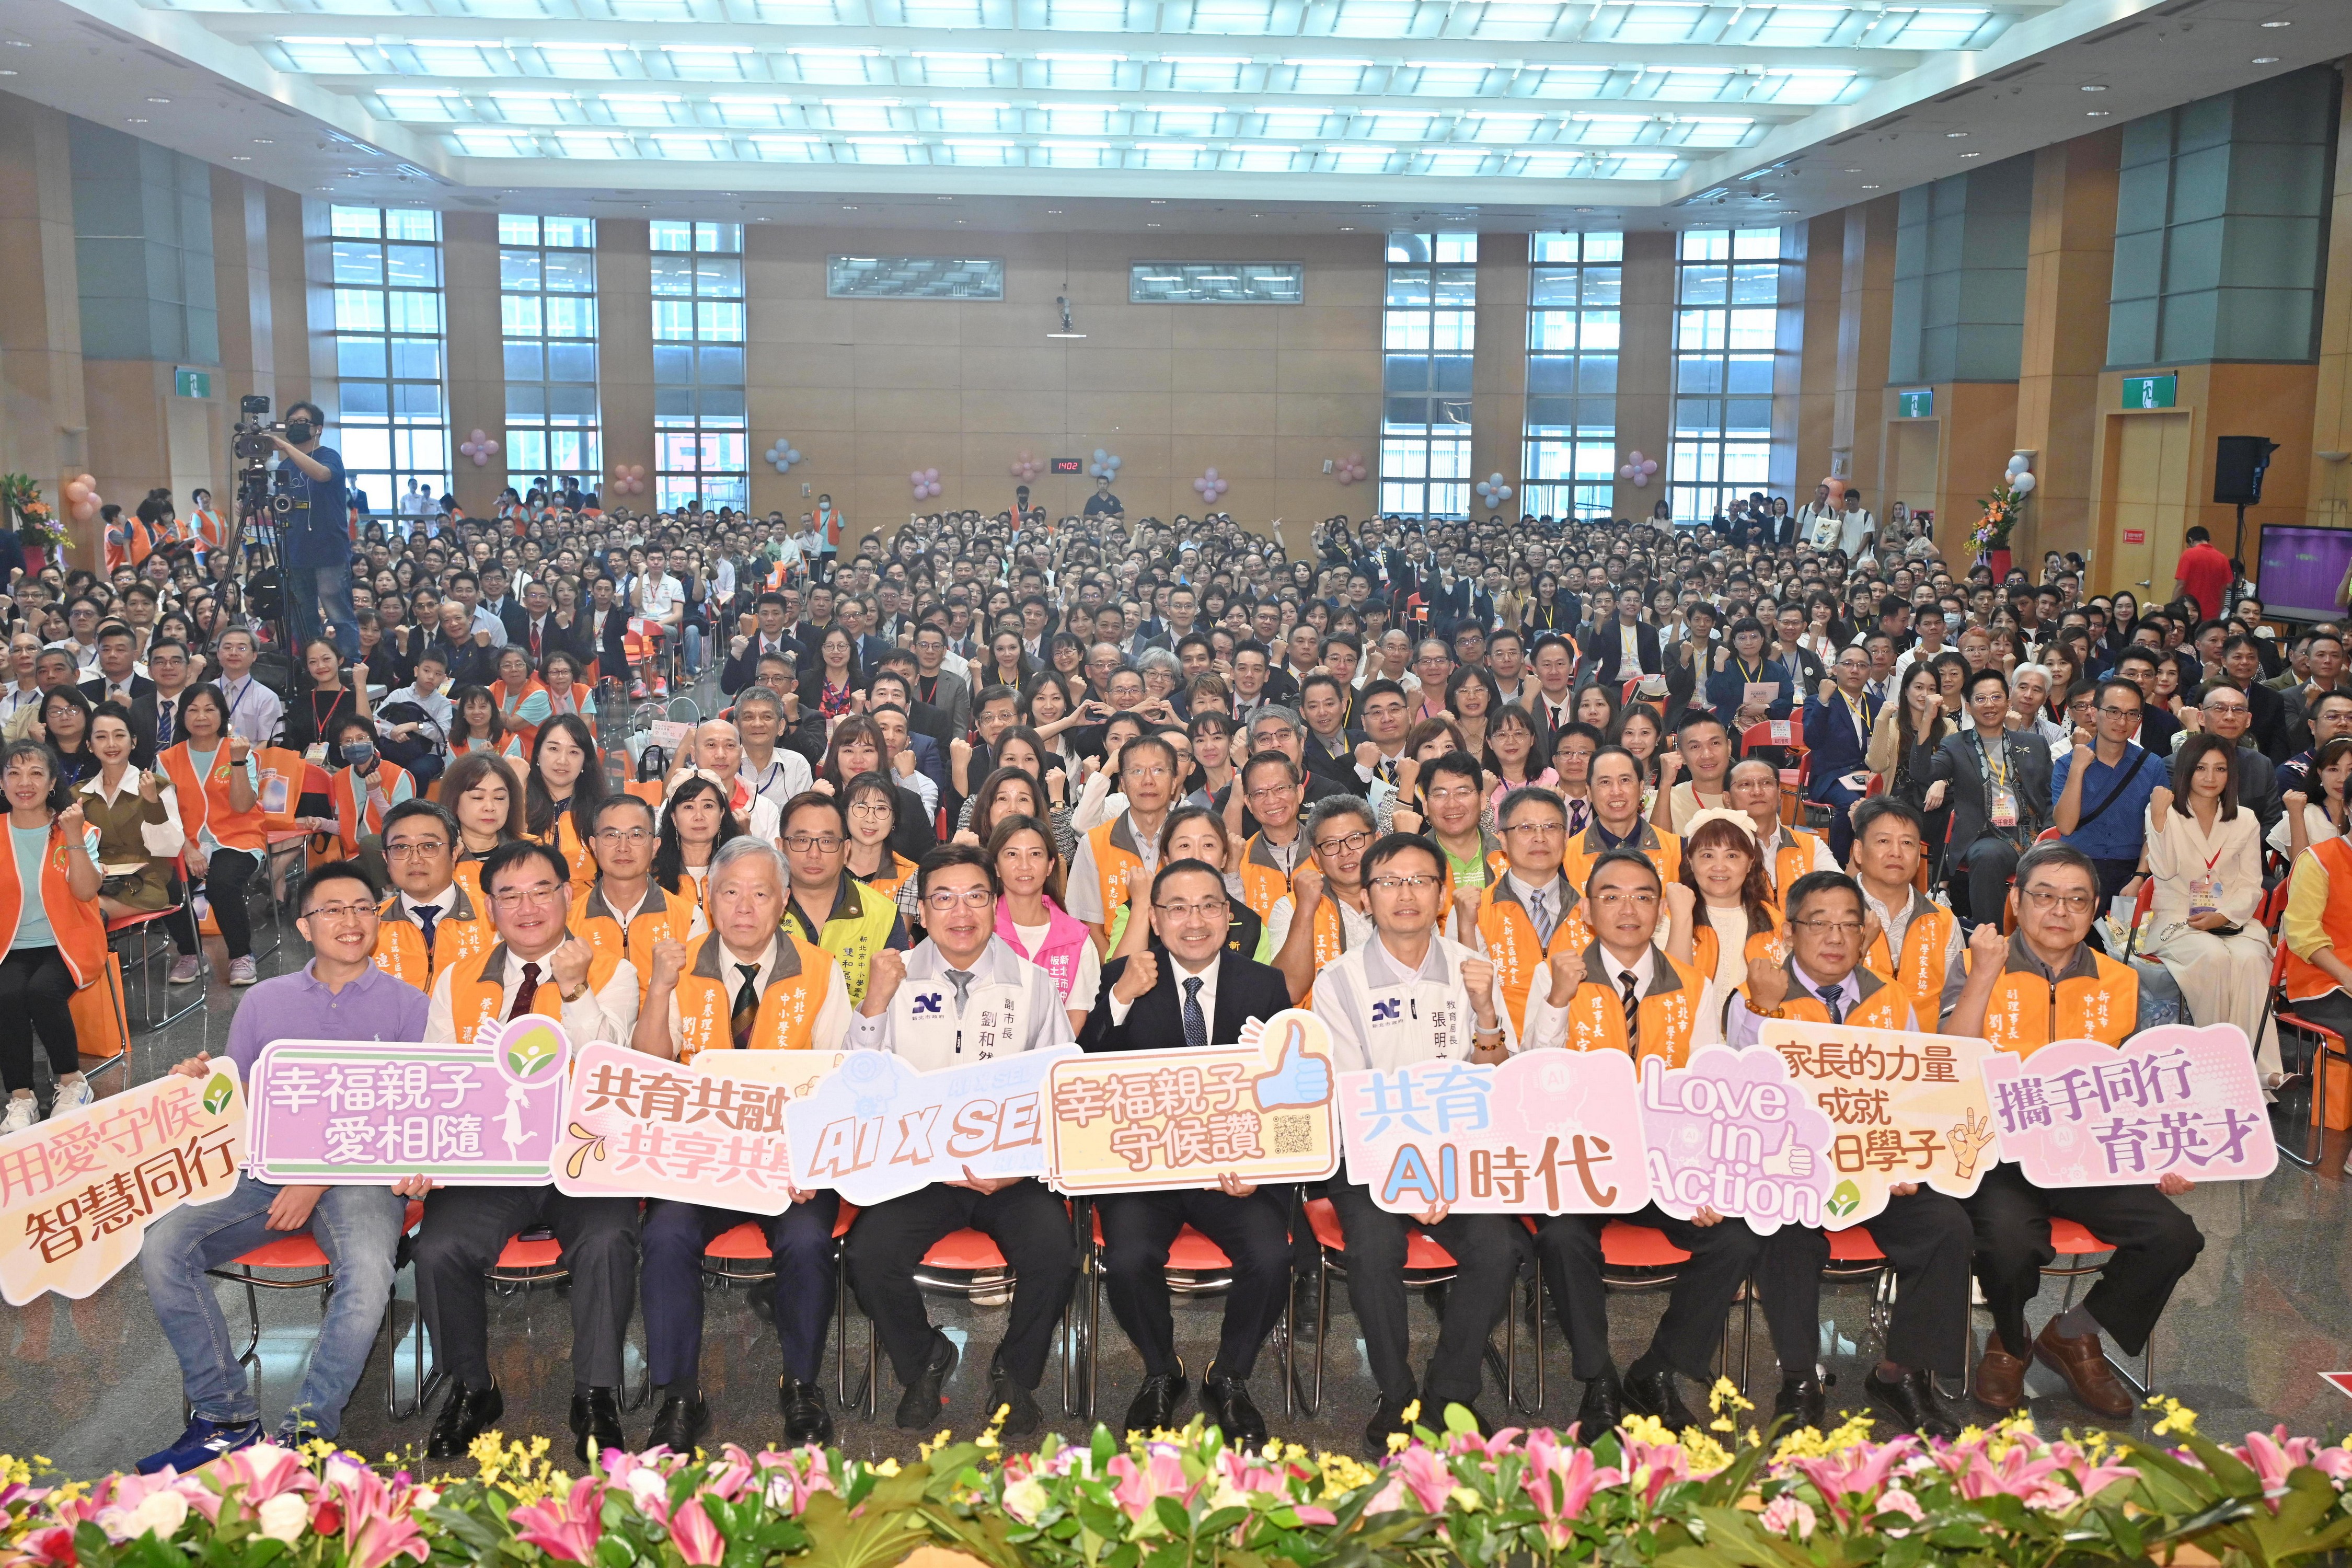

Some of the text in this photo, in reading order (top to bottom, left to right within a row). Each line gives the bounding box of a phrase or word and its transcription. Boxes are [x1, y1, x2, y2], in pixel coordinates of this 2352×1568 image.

[1315, 934, 1328, 967] 王茂
[777, 993, 791, 1050] 中小學家
[793, 987, 808, 1025] 新北市
[1002, 998, 1015, 1040] 副市長
[1372, 1019, 1404, 1029] 新北市政府
[1446, 1000, 1458, 1045] 教育局長
[1590, 996, 1605, 1038] 理事長
[1676, 994, 1689, 1033] 新北市
[2007, 989, 2020, 1039] 副理事長
[2096, 989, 2110, 1028] 新北市
[1988, 1013, 2005, 1053] 劉文
[1546, 1073, 1565, 1084] AI
[1775, 1040, 1959, 1083] 家長的力量
[269, 1063, 482, 1114] 幸福親子
[1056, 1062, 1254, 1128] 幸福親子
[1359, 1064, 1493, 1143] 共育
[1645, 1057, 1789, 1122] Love
[1818, 1087, 1892, 1126] 成就
[1994, 1048, 2193, 1134] 攜手同行
[1, 1087, 205, 1208] 用愛守候
[325, 1114, 484, 1164] 愛相隨
[1110, 1110, 1265, 1172] 守候讚
[1710, 1107, 1765, 1166] in
[1827, 1128, 1946, 1173] 日學子
[2092, 1108, 2261, 1174] 育英才
[26, 1124, 236, 1264] 智慧同行
[1647, 1147, 1821, 1226] Action
